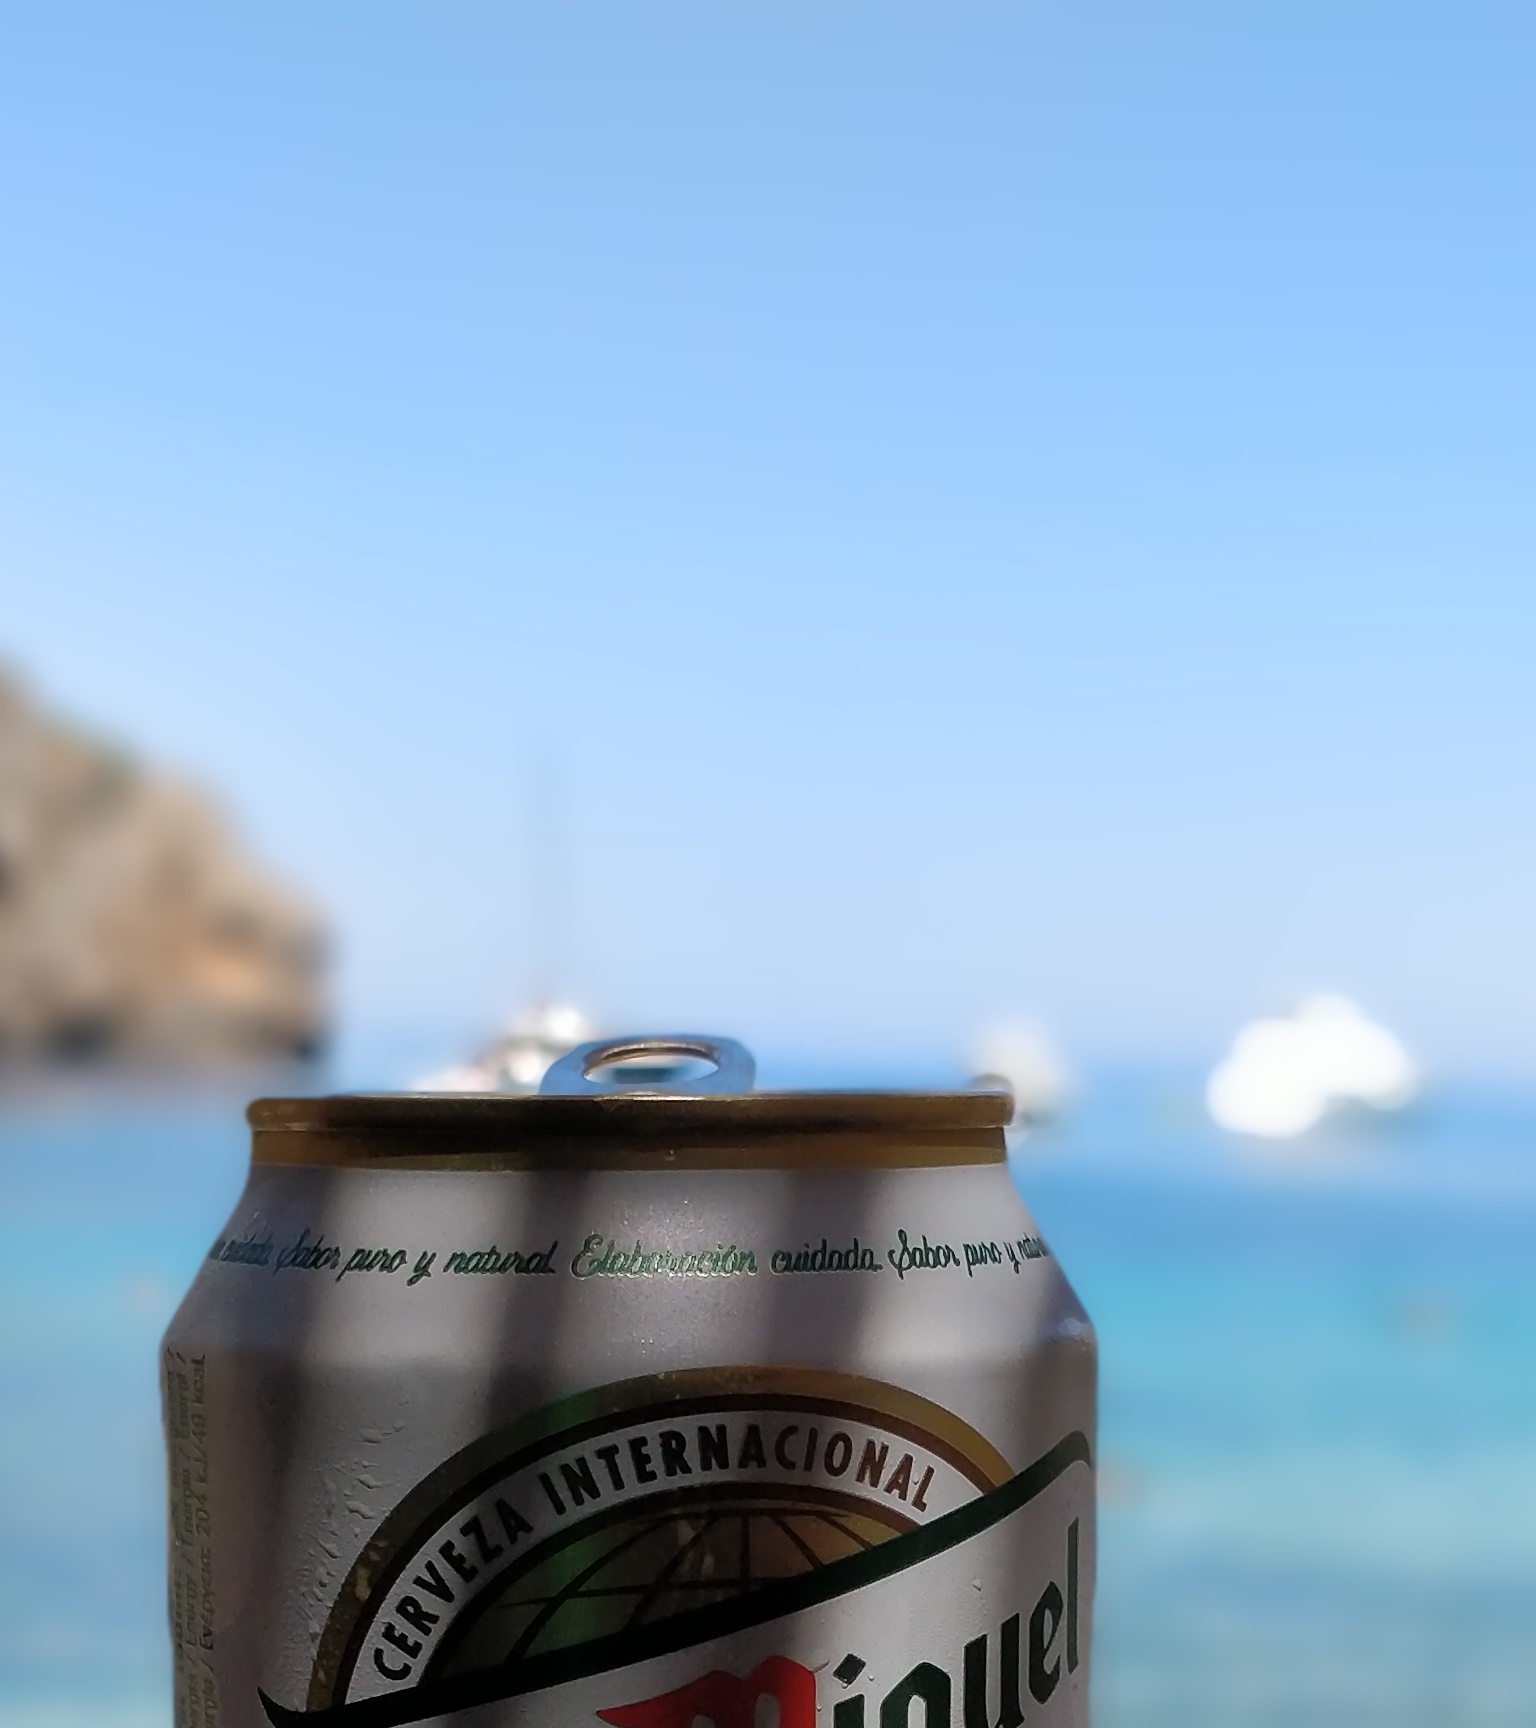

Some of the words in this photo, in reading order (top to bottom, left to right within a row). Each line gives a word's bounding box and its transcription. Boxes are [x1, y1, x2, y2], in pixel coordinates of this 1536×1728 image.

[335, 1247, 408, 1283] puro
[407, 1250, 437, 1287] y
[887, 1227, 961, 1281] Sabor
[963, 1241, 1003, 1278] puro
[1003, 1241, 1022, 1275] y
[372, 1497, 535, 1684] CERVEZA
[538, 1422, 935, 1520] INTERNACIONAL
